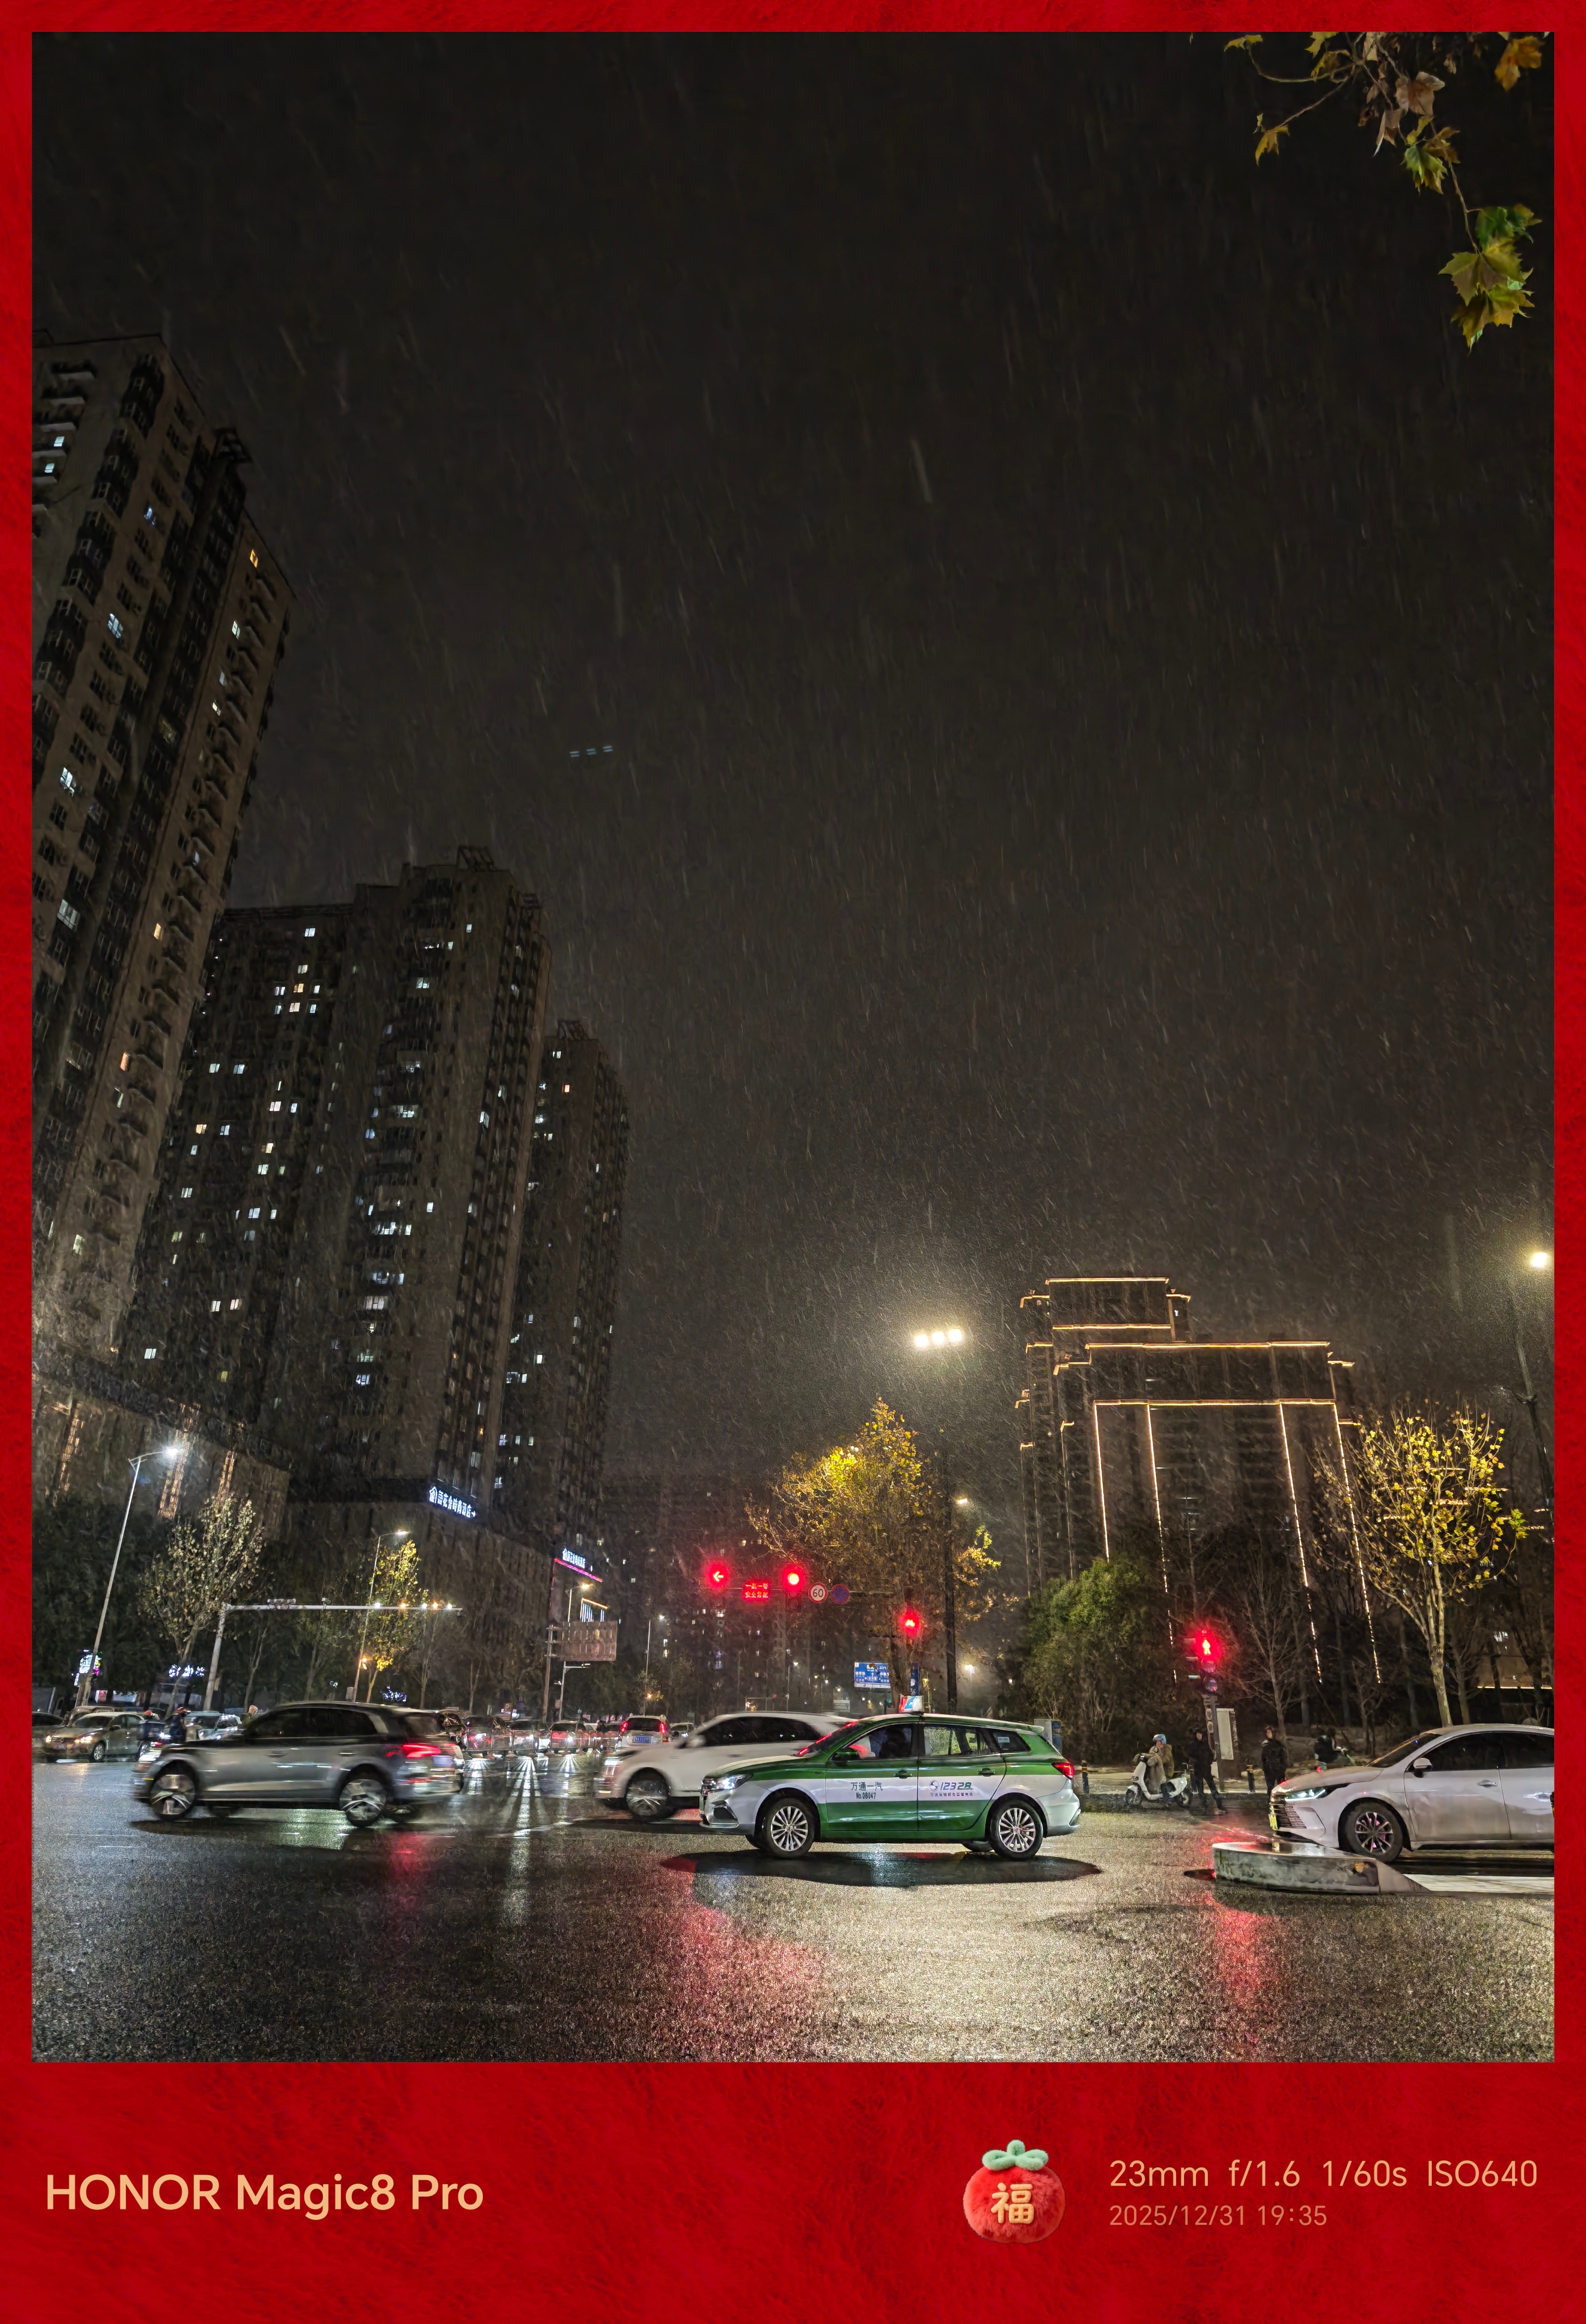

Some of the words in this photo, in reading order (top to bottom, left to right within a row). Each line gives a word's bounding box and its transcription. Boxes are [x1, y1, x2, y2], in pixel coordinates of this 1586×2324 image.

[813, 1588, 824, 1598] 60
[850, 1781, 883, 1791] 万通一汽
[940, 1782, 972, 1791] 12328
